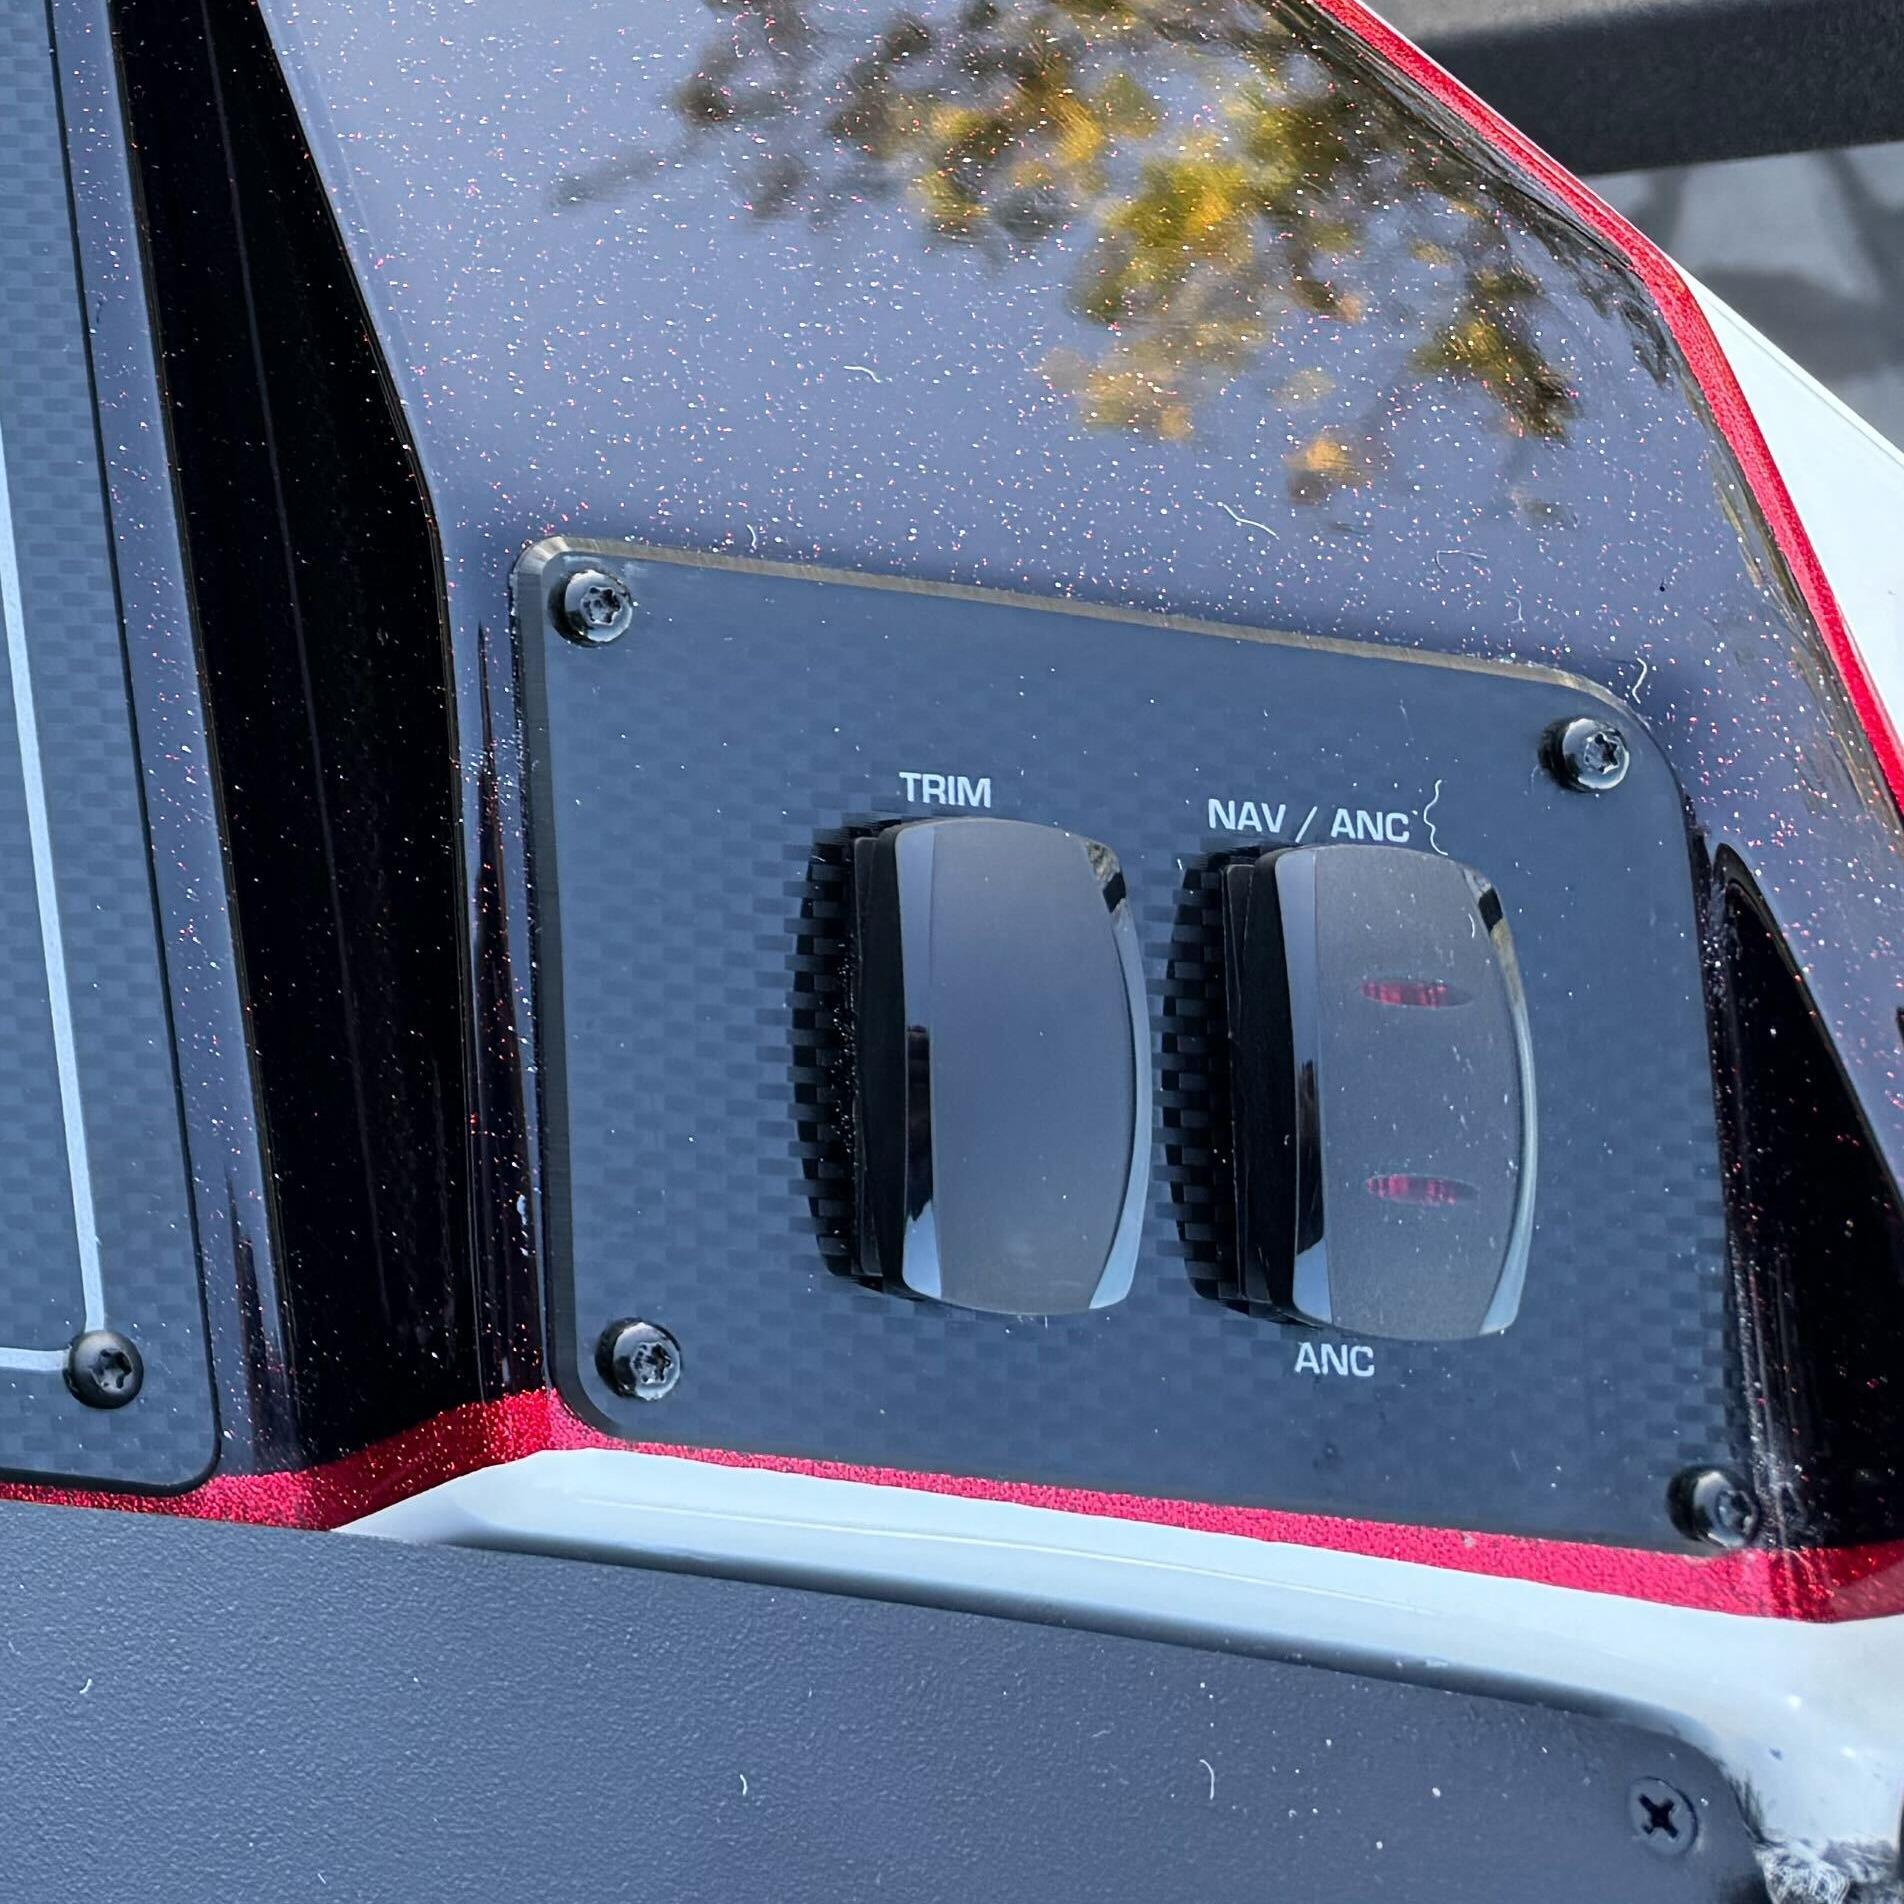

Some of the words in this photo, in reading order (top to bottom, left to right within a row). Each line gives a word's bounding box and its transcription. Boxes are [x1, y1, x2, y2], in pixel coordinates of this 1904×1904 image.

[899, 772, 992, 808] TRIM
[1208, 798, 1286, 834] NAV
[1295, 806, 1318, 843] /
[1330, 808, 1410, 844] ANC
[1295, 1341, 1376, 1377] ANC
